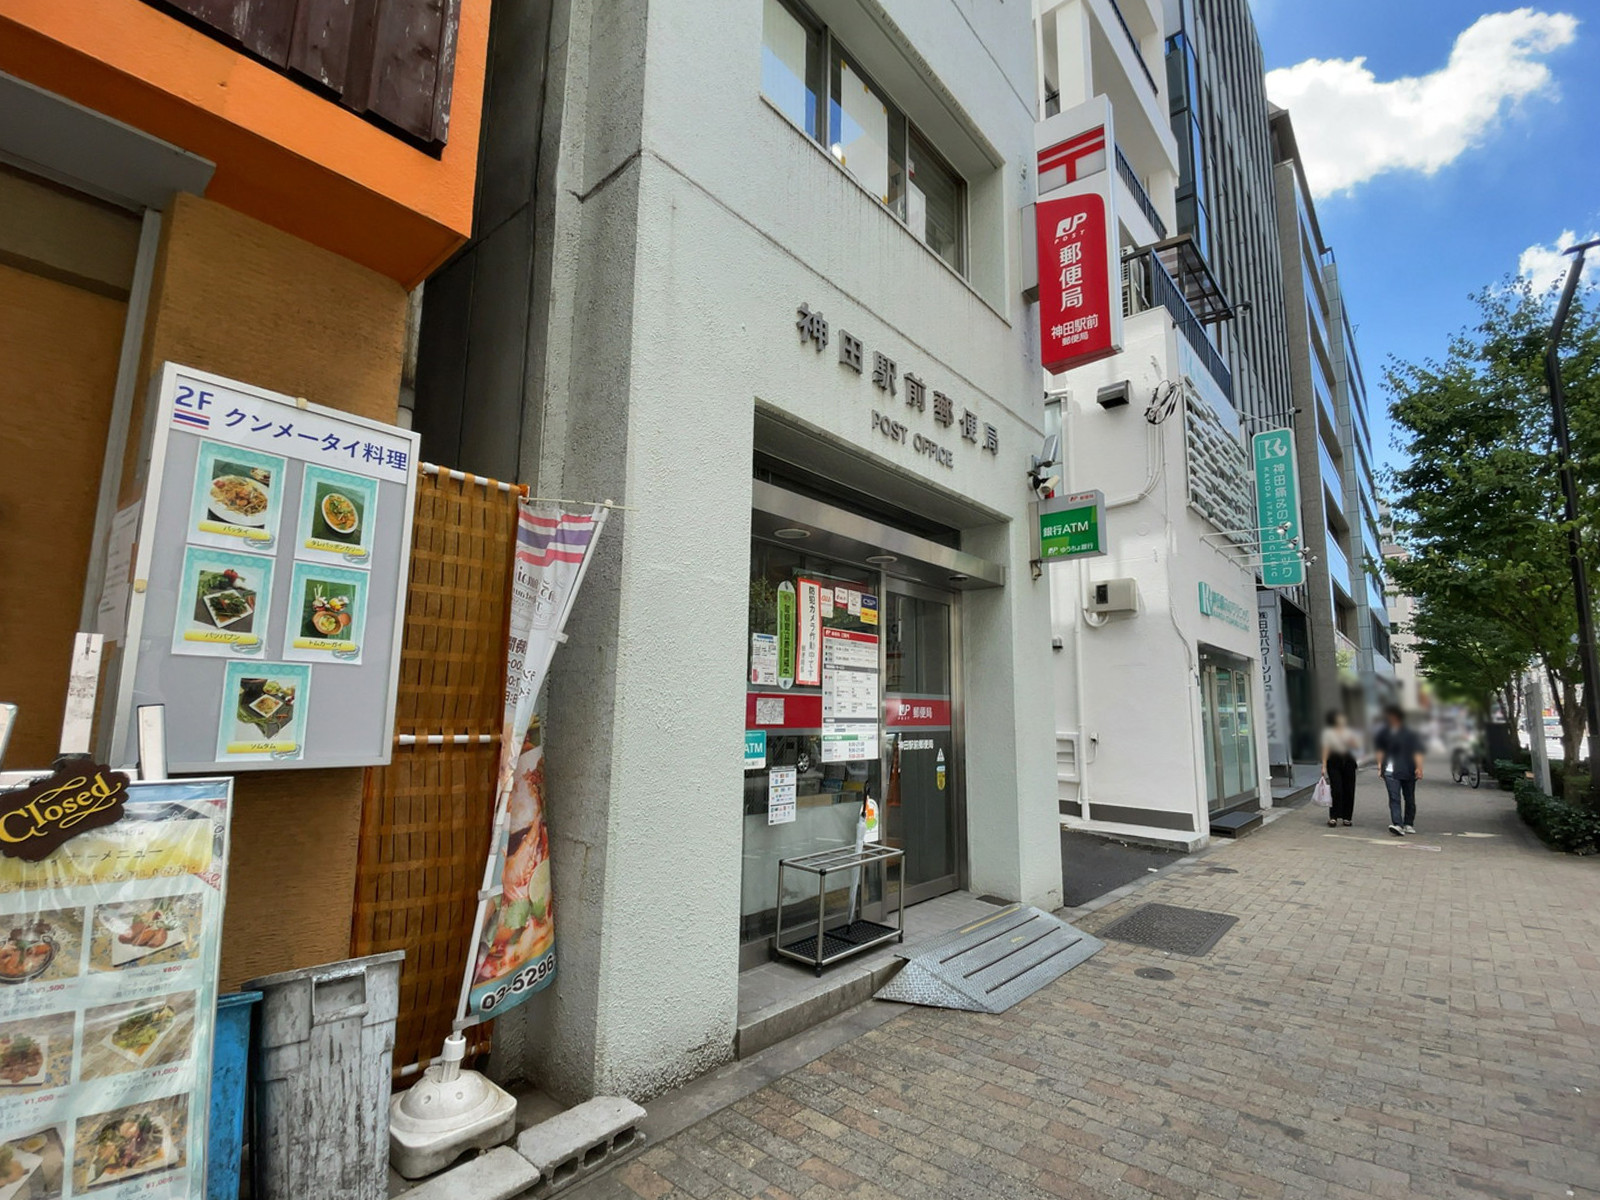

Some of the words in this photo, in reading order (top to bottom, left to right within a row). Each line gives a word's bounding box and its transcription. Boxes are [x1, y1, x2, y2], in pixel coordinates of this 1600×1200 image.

[1054, 229, 1086, 244] POST
[1059, 241, 1084, 313] 郵便局
[1051, 313, 1099, 340] 神田駅前
[1061, 333, 1089, 347] 郵便局
[796, 302, 999, 457] 神田駅前郵便局
[175, 385, 214, 410] 2F
[225, 408, 407, 472] クンメータイ料理
[871, 409, 909, 444] POST
[912, 432, 954, 469] OFFICE
[1042, 520, 1089, 537] 銀行ATM
[0, 772, 121, 843] Closed
